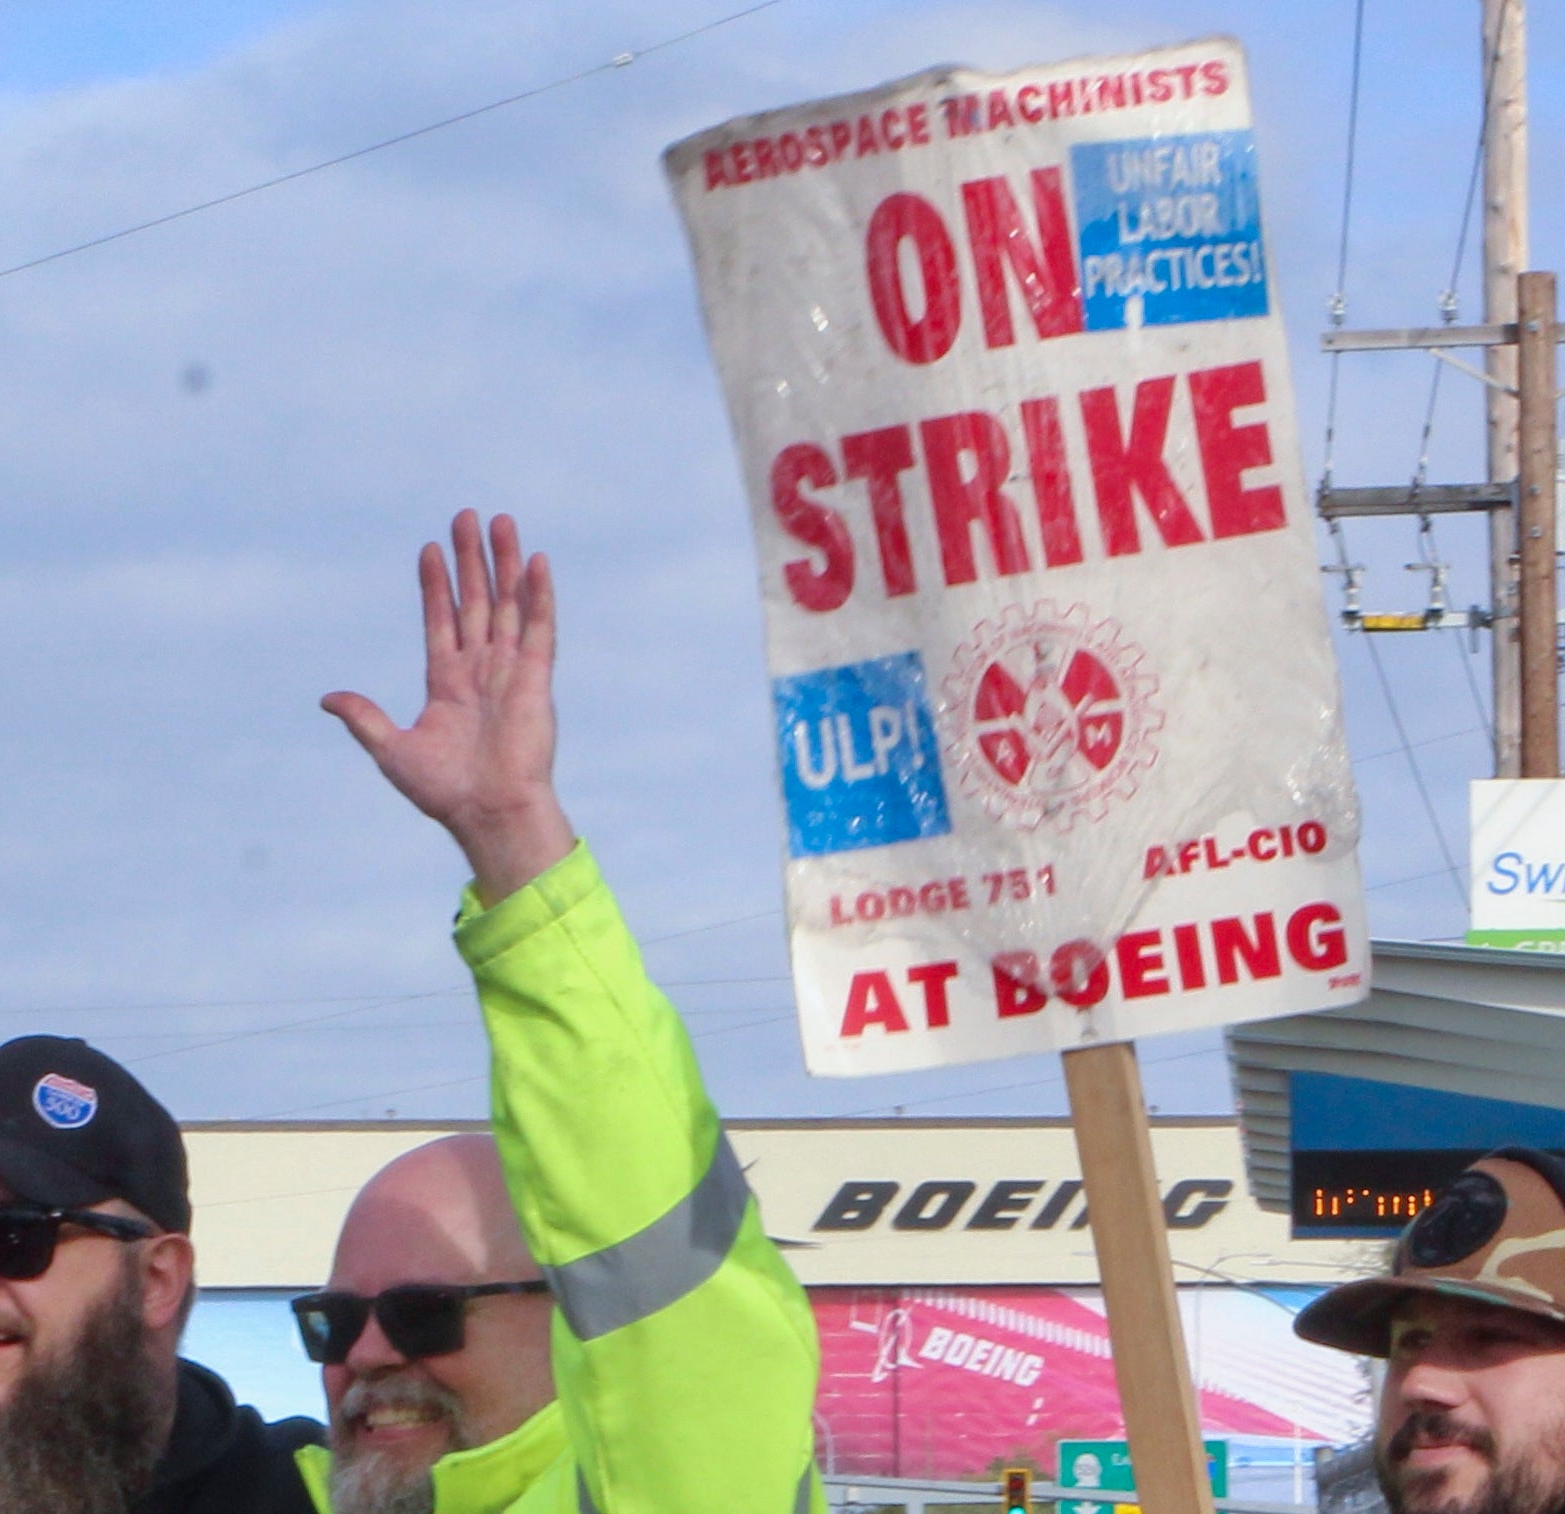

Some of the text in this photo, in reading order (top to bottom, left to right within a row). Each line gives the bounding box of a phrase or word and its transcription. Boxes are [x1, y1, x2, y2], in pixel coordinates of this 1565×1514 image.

[705, 59, 1231, 192] AEROSPACE MACHINISTS
[1107, 143, 1223, 195] UNFAIR
[1117, 194, 1224, 245] LABOR
[865, 165, 1086, 366] ON
[1085, 241, 1265, 299] PRACTICES!
[770, 359, 1288, 612] STRIKE
[793, 699, 926, 790] ULP!
[1141, 819, 1328, 881] AFL-CIO
[830, 863, 1057, 928] LODGE 751
[837, 901, 1349, 1039] AT BOEING
[810, 1178, 1234, 1232] BOEIG
[918, 1326, 1045, 1388] BOEING
